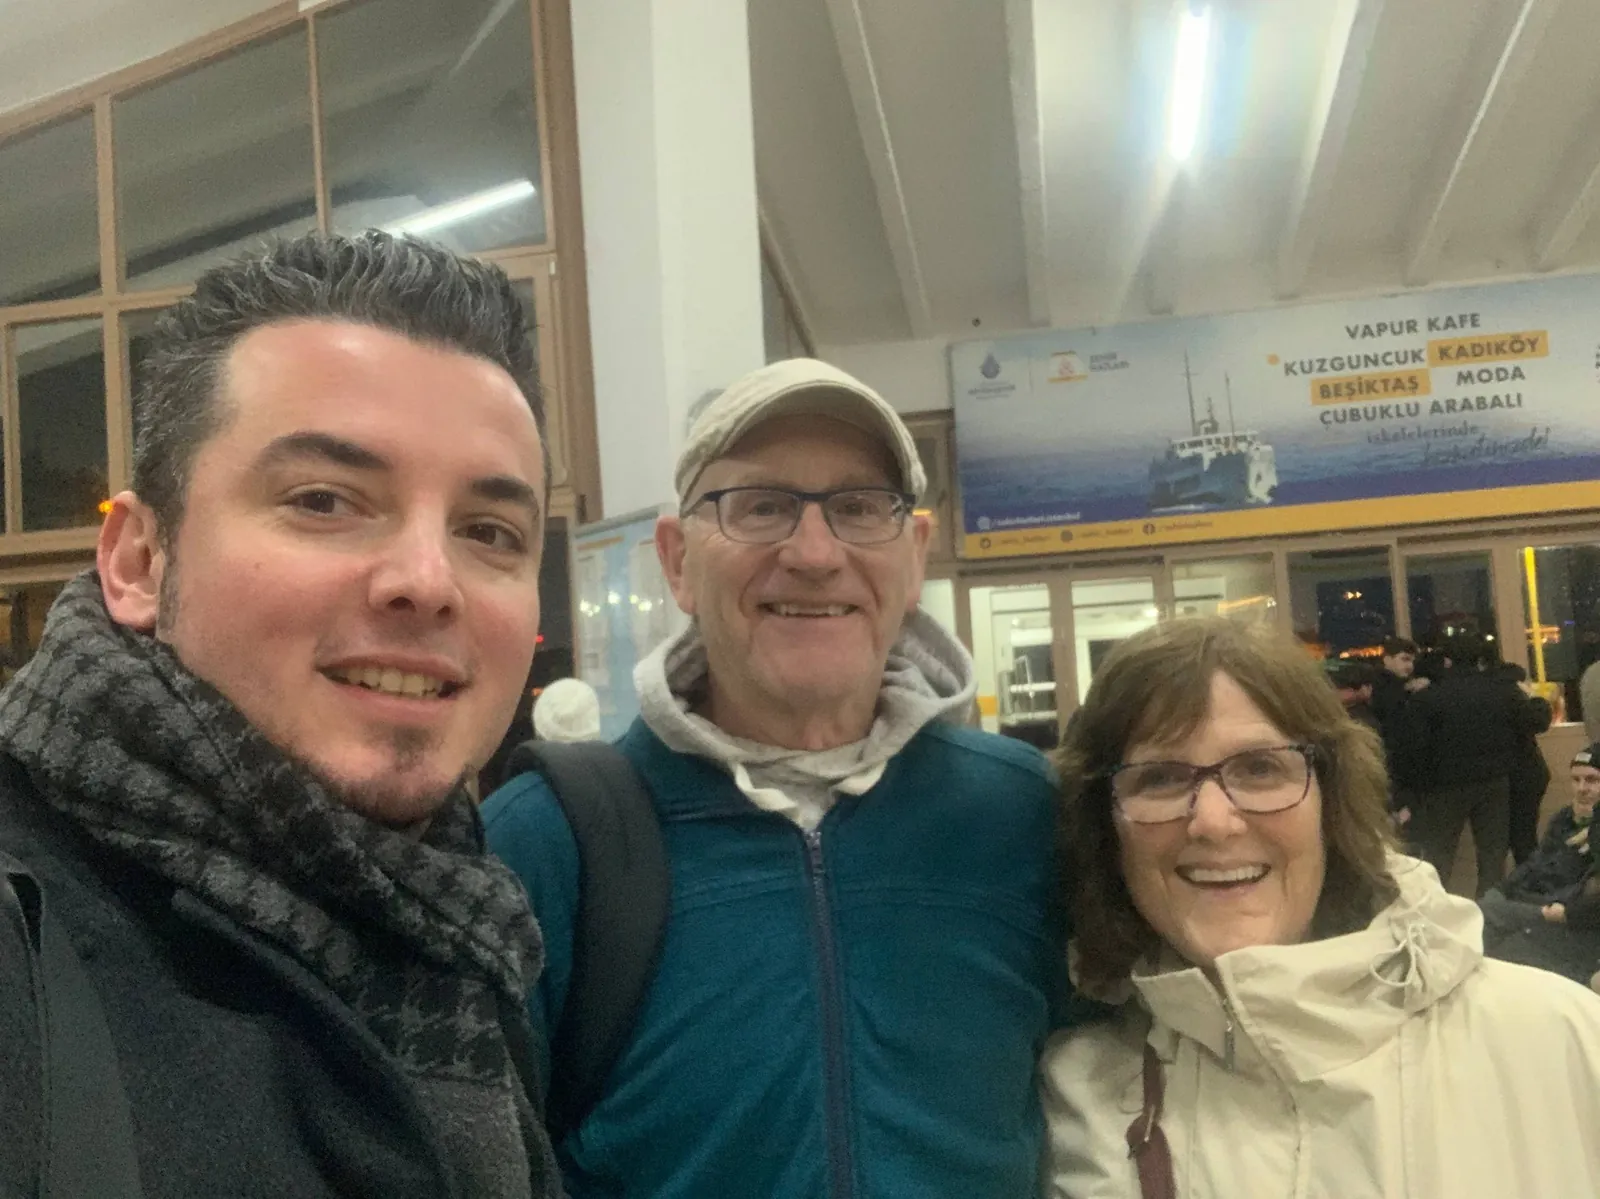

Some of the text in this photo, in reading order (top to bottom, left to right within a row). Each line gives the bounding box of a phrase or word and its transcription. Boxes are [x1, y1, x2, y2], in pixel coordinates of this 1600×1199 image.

[1344, 313, 1482, 341] VAPUR KAFE
[1284, 335, 1540, 377] KUZGUNCUK KADIKÖY
[1319, 366, 1526, 402] BEŞİKTAŞ MODA
[1319, 392, 1523, 430] ÇUBUKLU ARABALI
